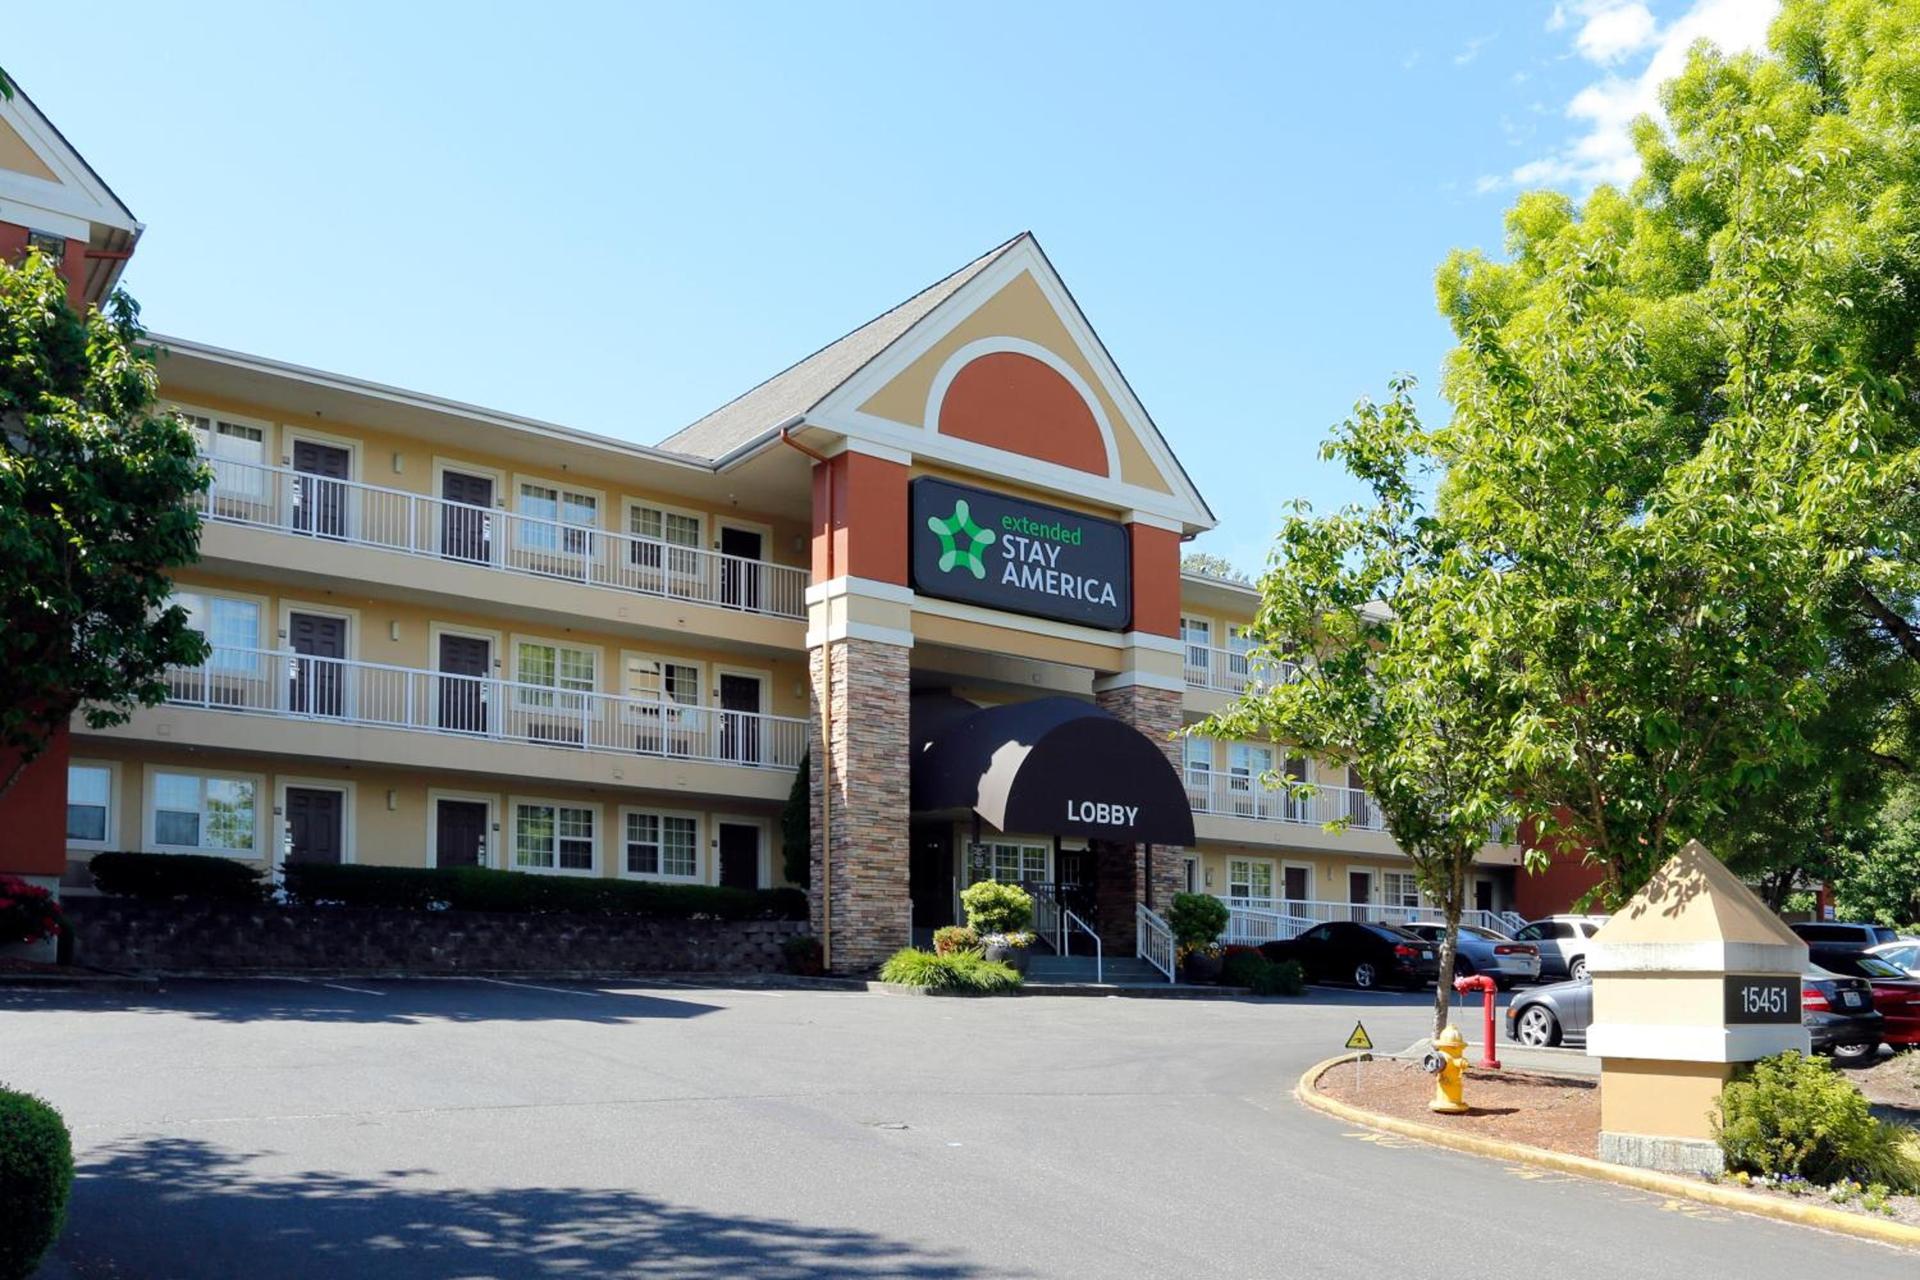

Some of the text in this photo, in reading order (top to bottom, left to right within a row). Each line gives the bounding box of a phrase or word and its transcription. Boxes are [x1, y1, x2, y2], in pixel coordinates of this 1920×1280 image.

[1001, 515, 1081, 545] extended
[1002, 533, 1061, 568] STAY
[1001, 561, 1117, 607] AMERICA
[1067, 800, 1138, 826] LOBBY
[1741, 986, 1787, 1013] 15451
